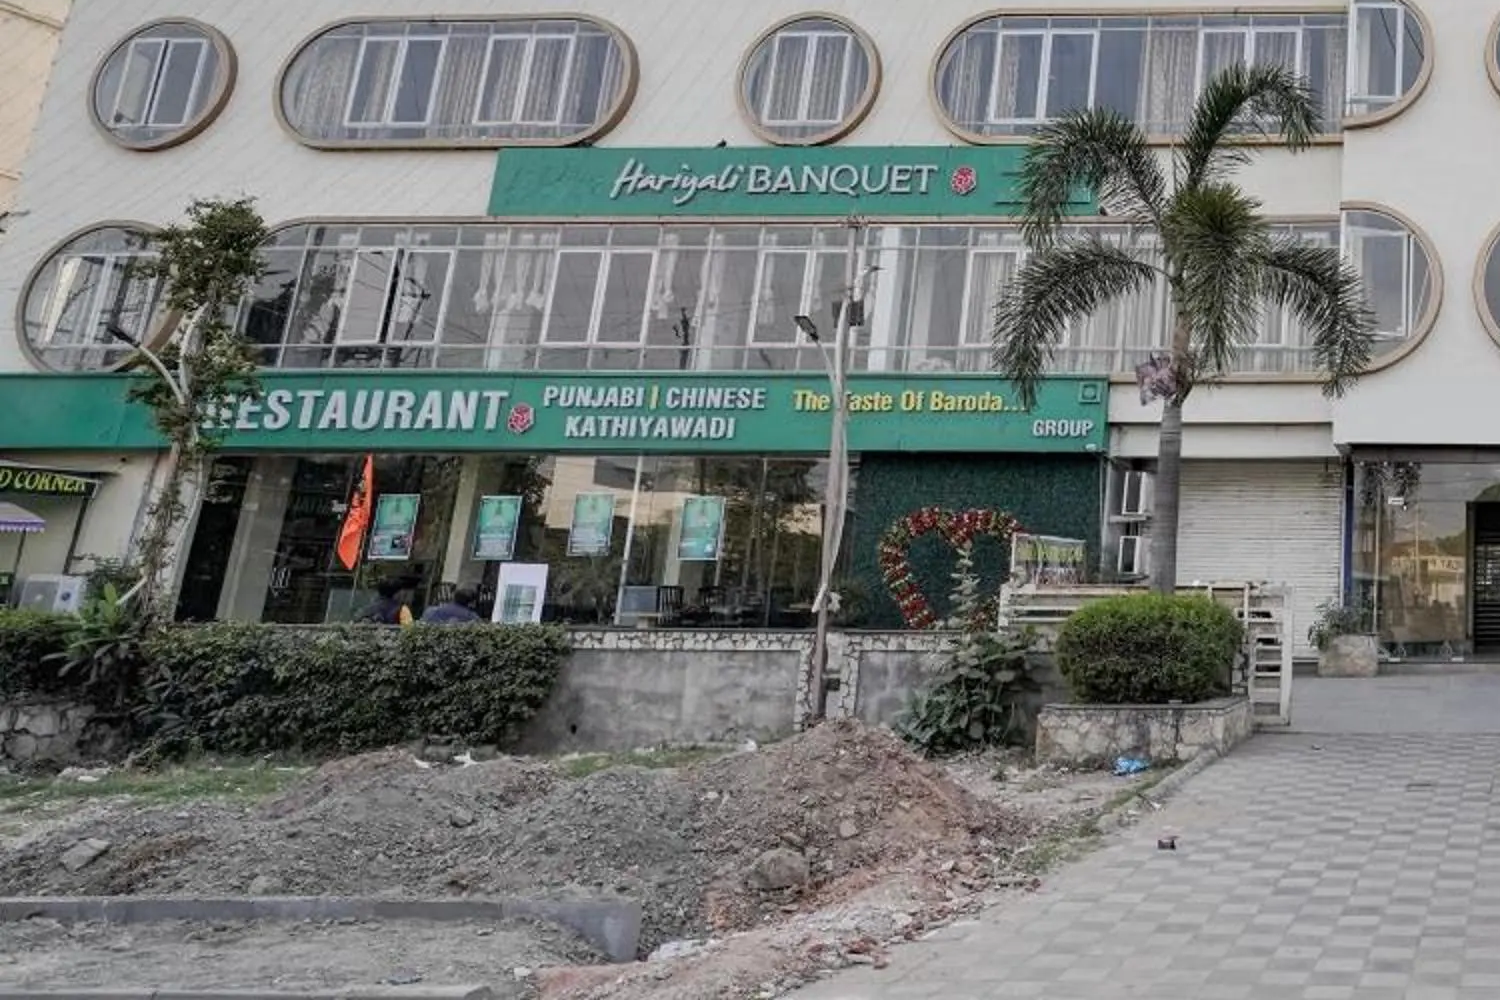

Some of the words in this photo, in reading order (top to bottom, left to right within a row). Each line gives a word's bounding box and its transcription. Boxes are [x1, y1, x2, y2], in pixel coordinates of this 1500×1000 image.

[609, 158, 744, 204] Hariyali
[746, 165, 937, 195] BANQUET
[544, 386, 646, 408] PUNJABI
[665, 387, 766, 409] CHINESE
[793, 389, 830, 411] The
[901, 391, 925, 412] Of
[564, 415, 736, 439] KATHIYAWADI
[1032, 419, 1094, 438] GROUP
[14, 471, 86, 492] CORNER
